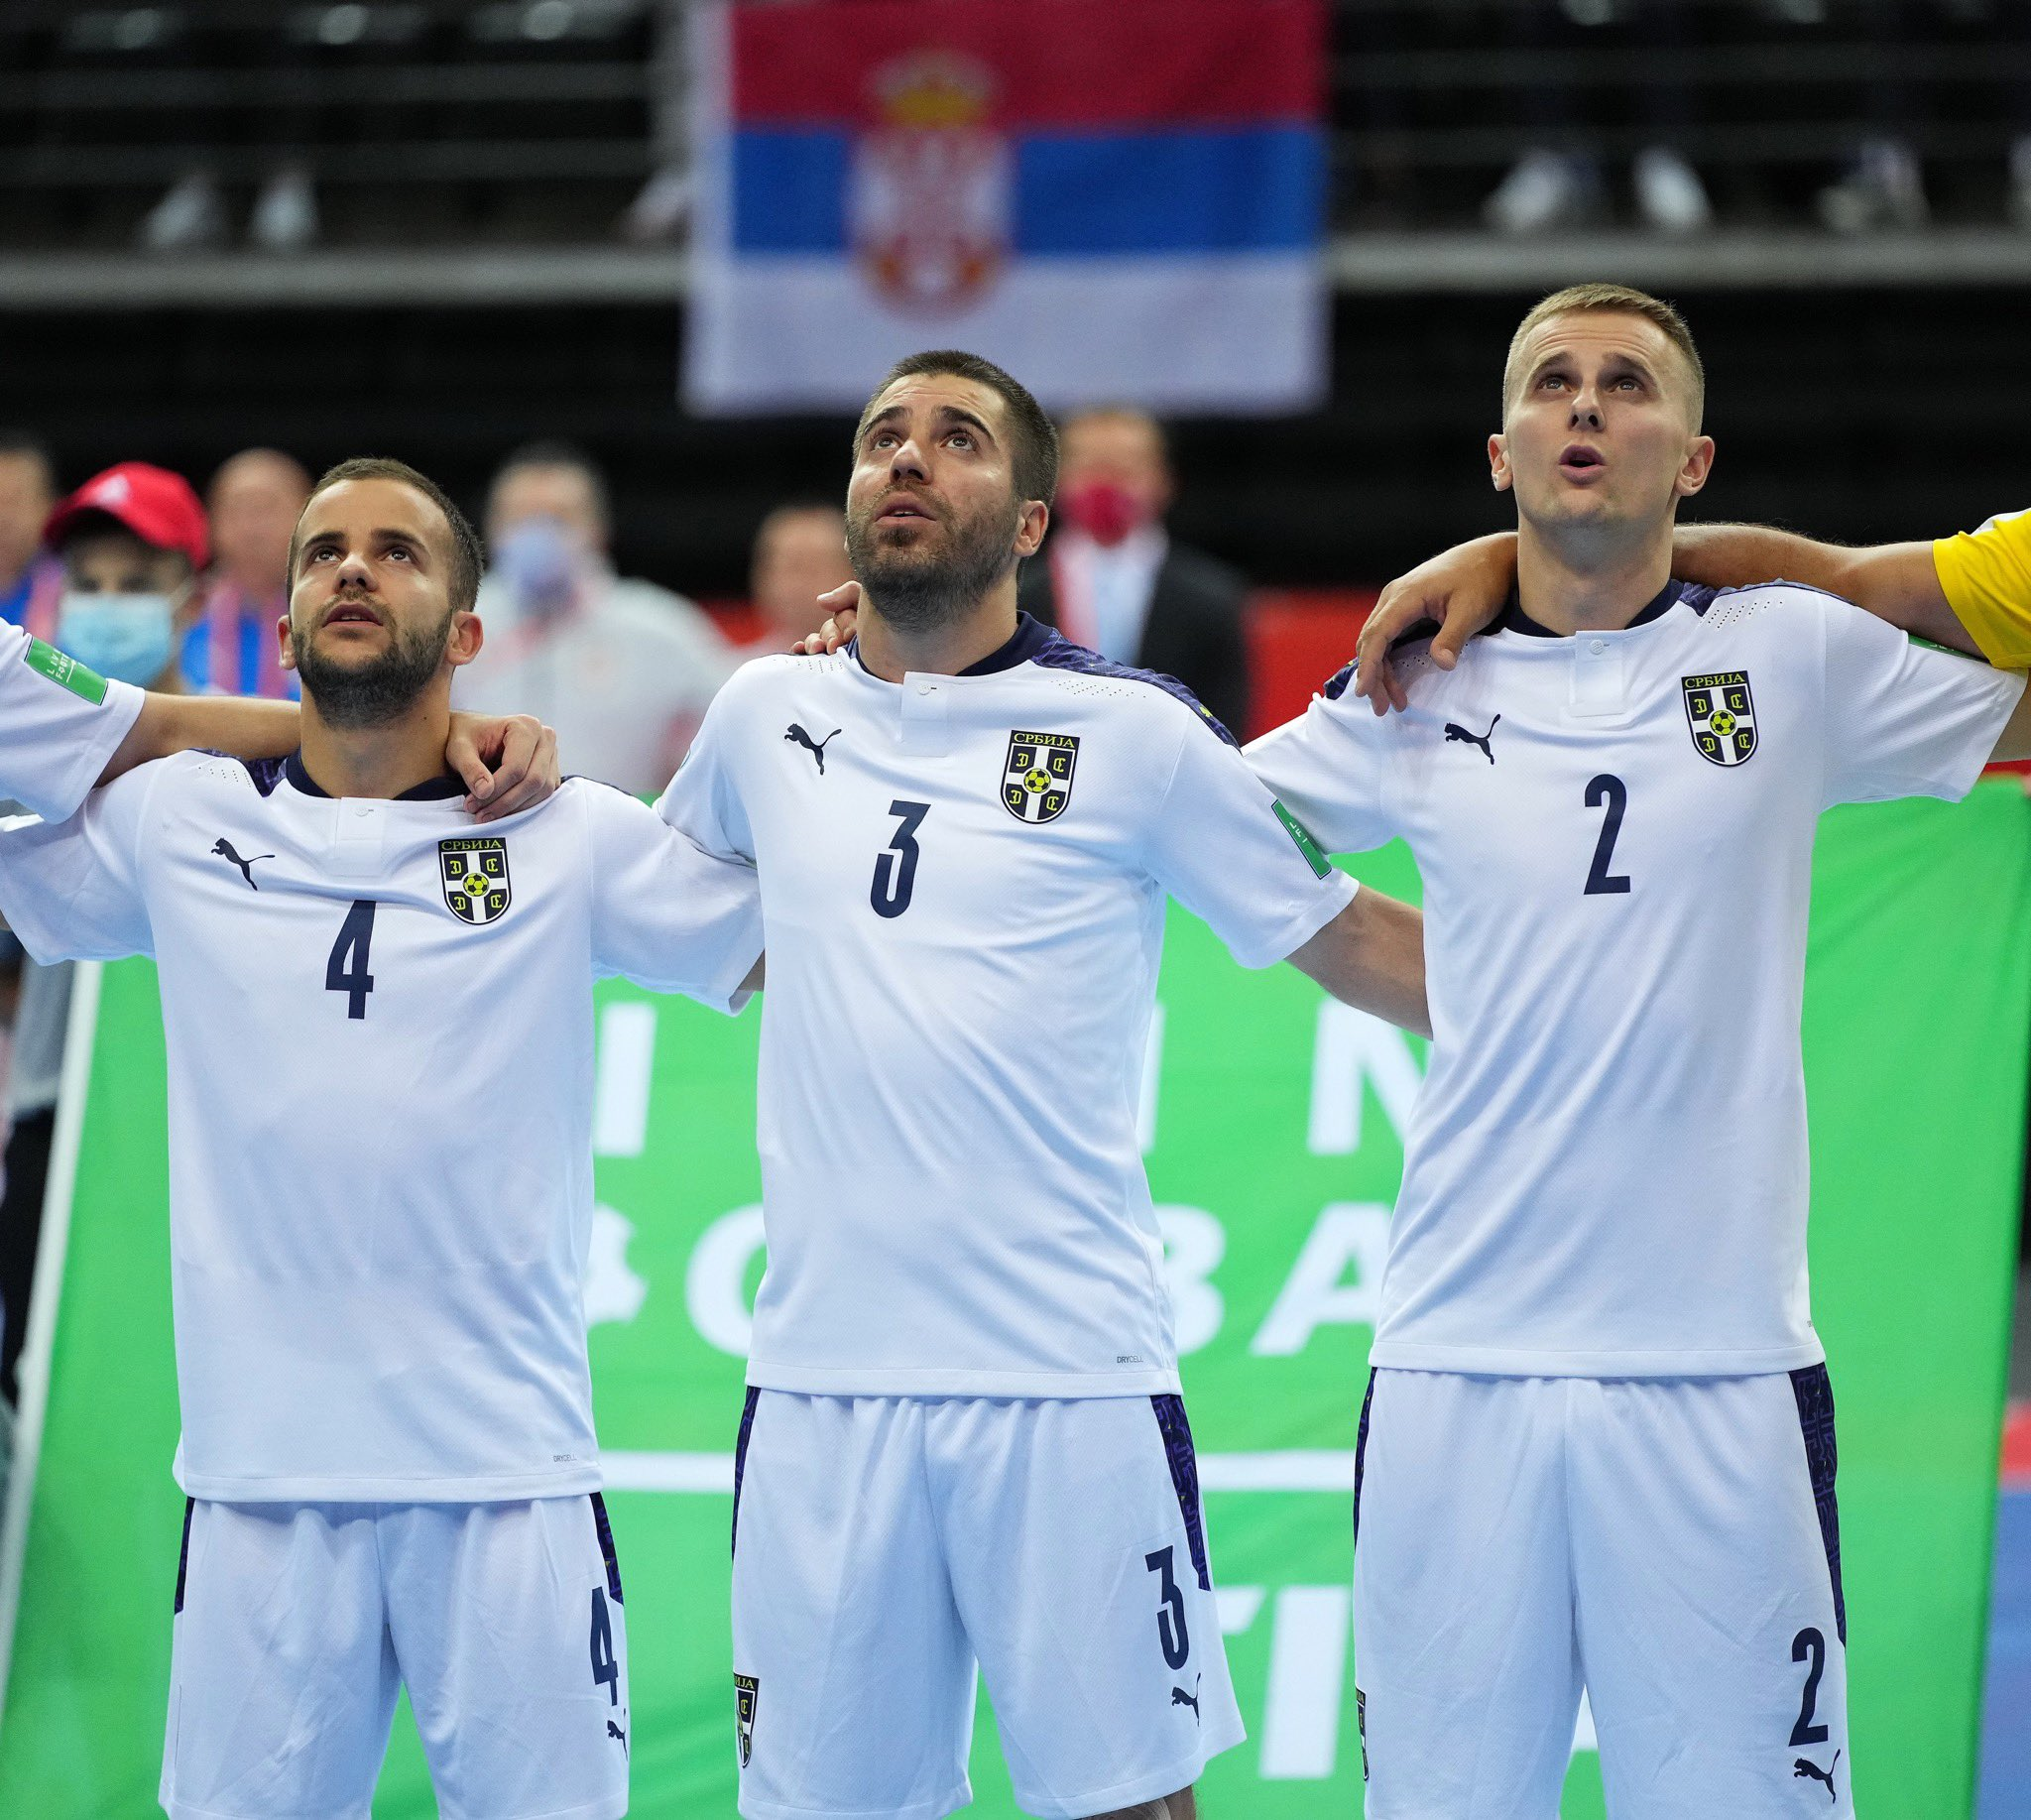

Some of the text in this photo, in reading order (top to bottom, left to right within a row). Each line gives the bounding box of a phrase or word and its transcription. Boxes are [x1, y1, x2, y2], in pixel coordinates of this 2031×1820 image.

[1014, 732, 1075, 748] СРБИЈА
[1685, 672, 1745, 688] СРБИЈА
[441, 839, 503, 851] СРБИЈА
[870, 799, 931, 918] 3
[1584, 775, 1631, 896] 2
[324, 900, 378, 1020] 4
[589, 1586, 619, 1707] 4
[1144, 1544, 1190, 1670] 3
[1788, 1628, 1829, 1748] 2
